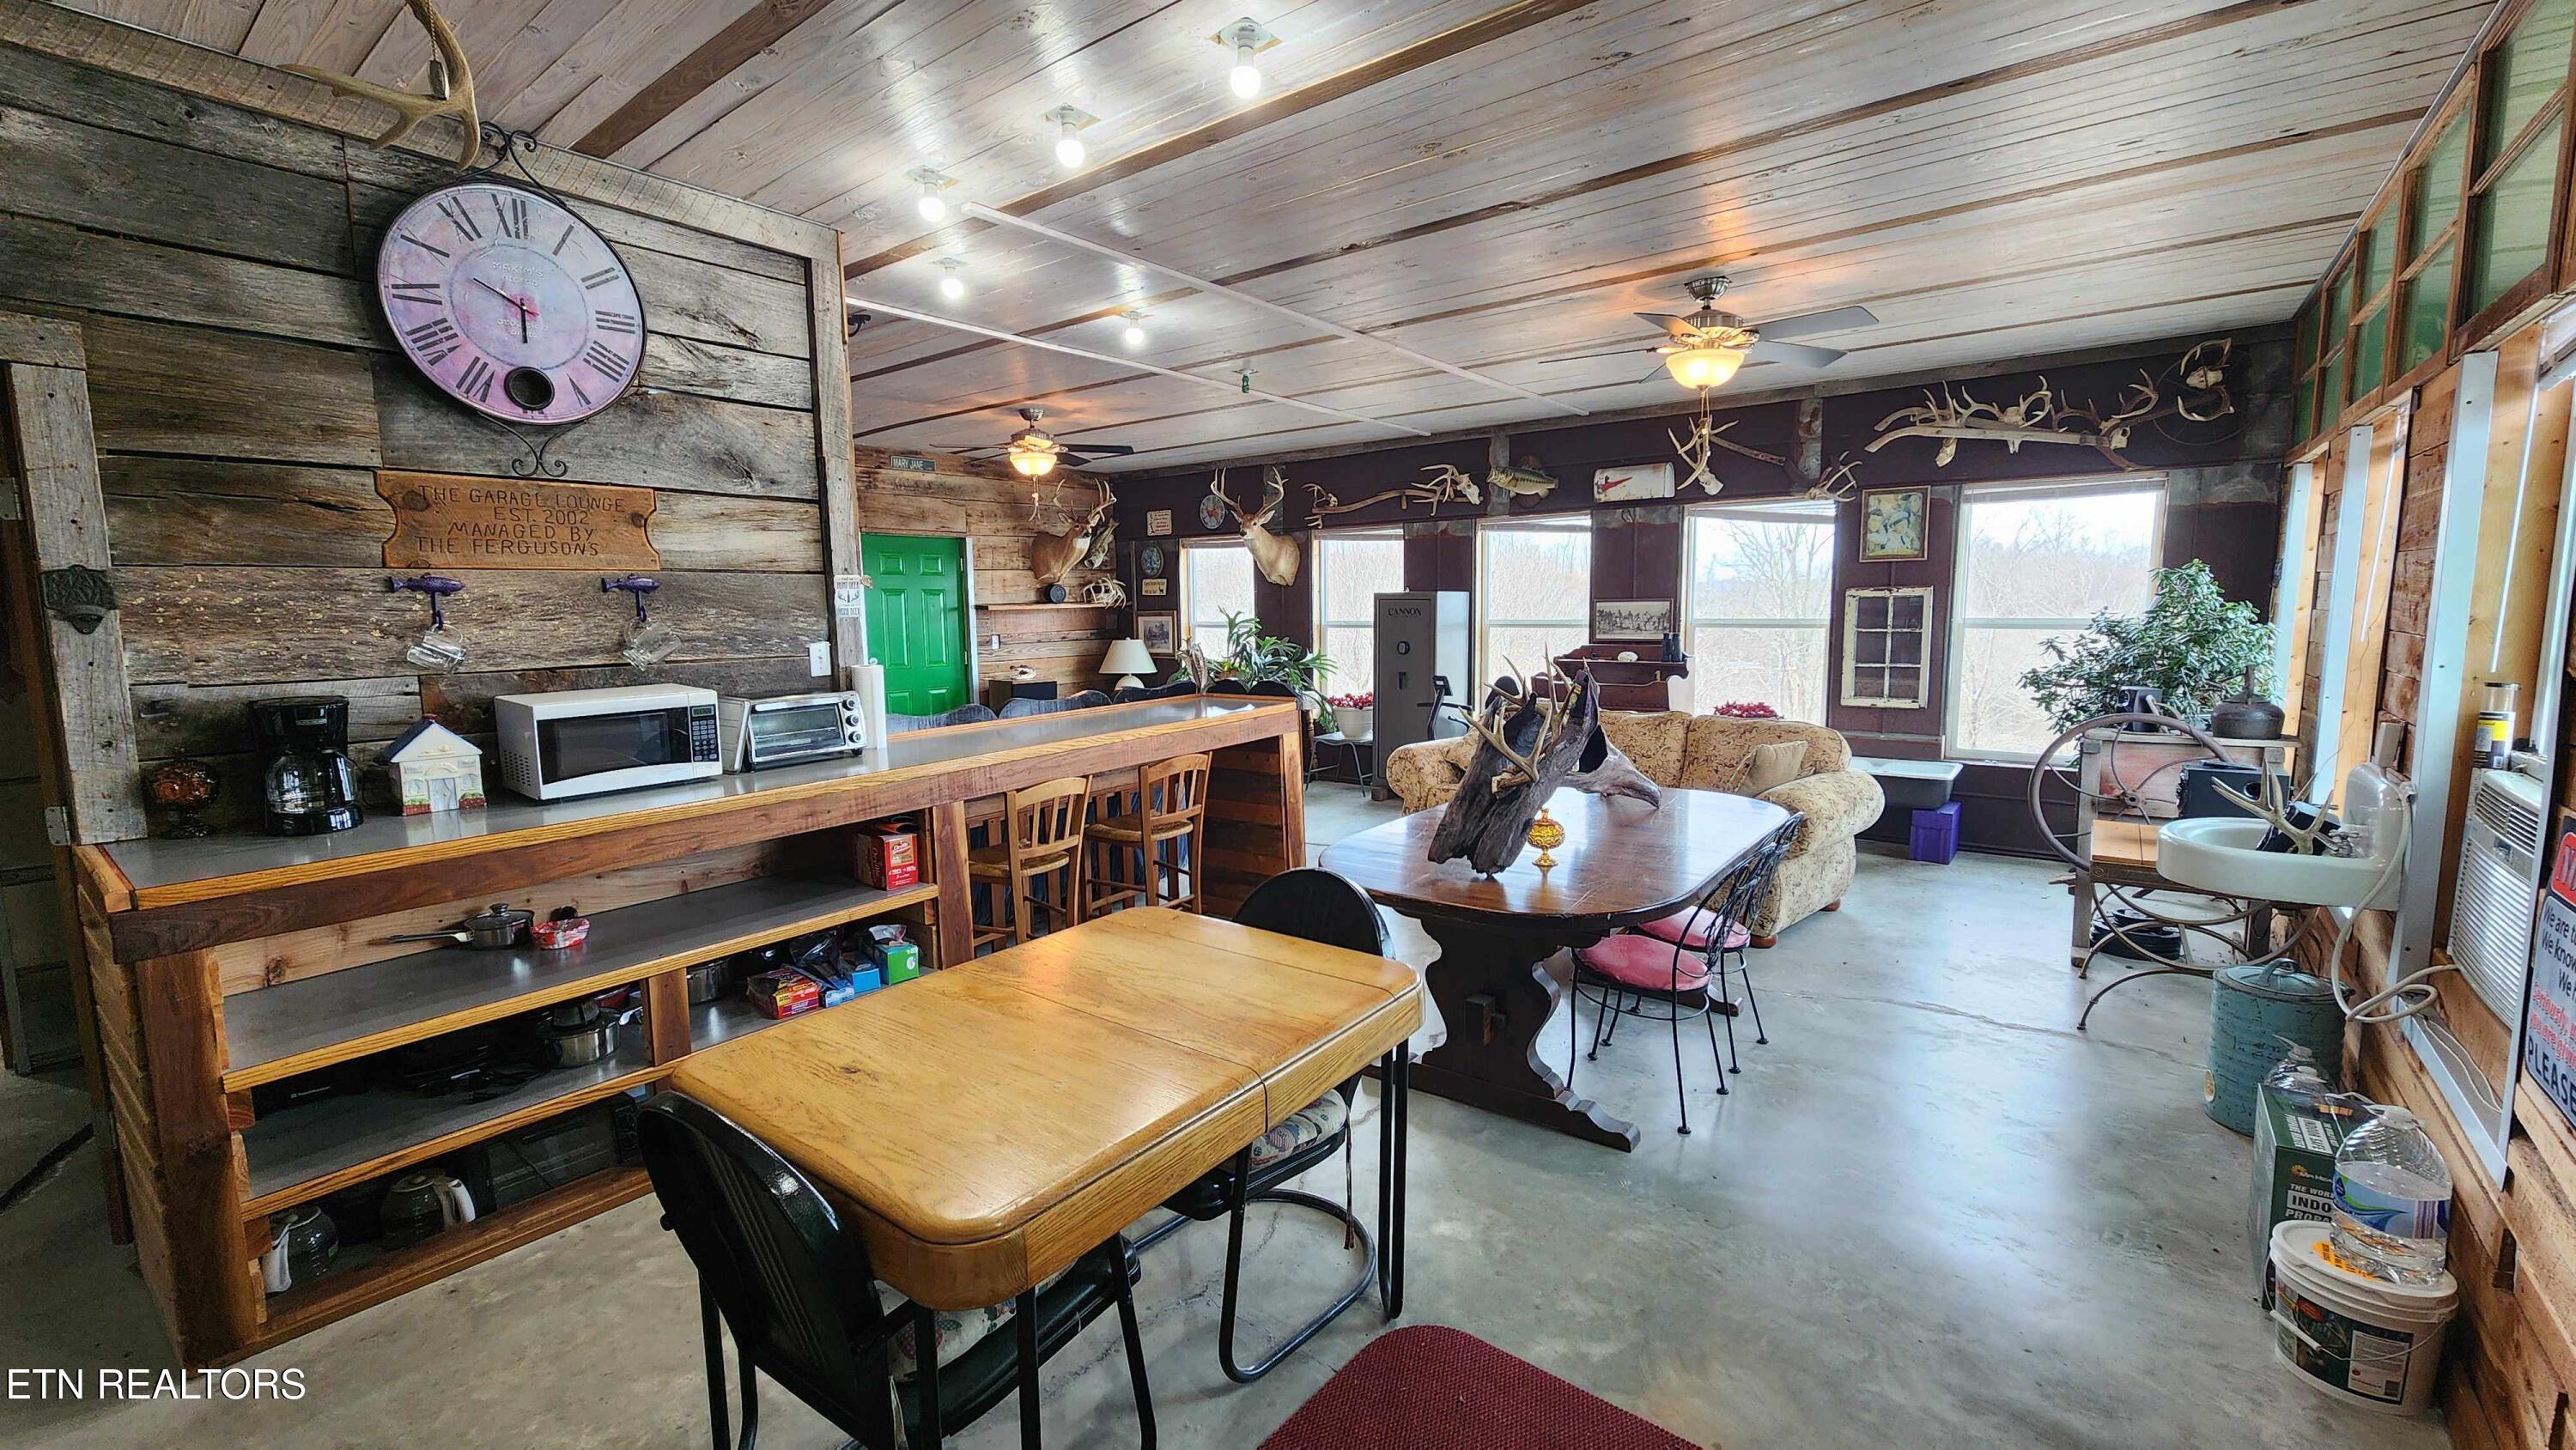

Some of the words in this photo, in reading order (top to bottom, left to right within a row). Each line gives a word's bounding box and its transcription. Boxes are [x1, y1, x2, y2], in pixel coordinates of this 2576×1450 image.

[893, 458, 908, 469] MARY
[910, 460, 924, 470] JANE
[418, 485, 461, 503] THE
[469, 488, 548, 507] GARAGE
[556, 494, 626, 513] LOUNGE
[494, 507, 536, 524] EST.
[544, 510, 589, 525] 2002
[448, 522, 556, 539] MANAGED
[570, 526, 597, 542] BY
[415, 536, 462, 554] THE
[1388, 607, 1421, 616] CANNON
[2543, 902, 2555, 928] We
[2555, 917, 2569, 939] are
[2542, 928, 2554, 955] We
[2559, 968, 2572, 997] We
[2528, 1034, 2576, 1115] PLEASE
[2290, 1183, 2307, 1193] THE
